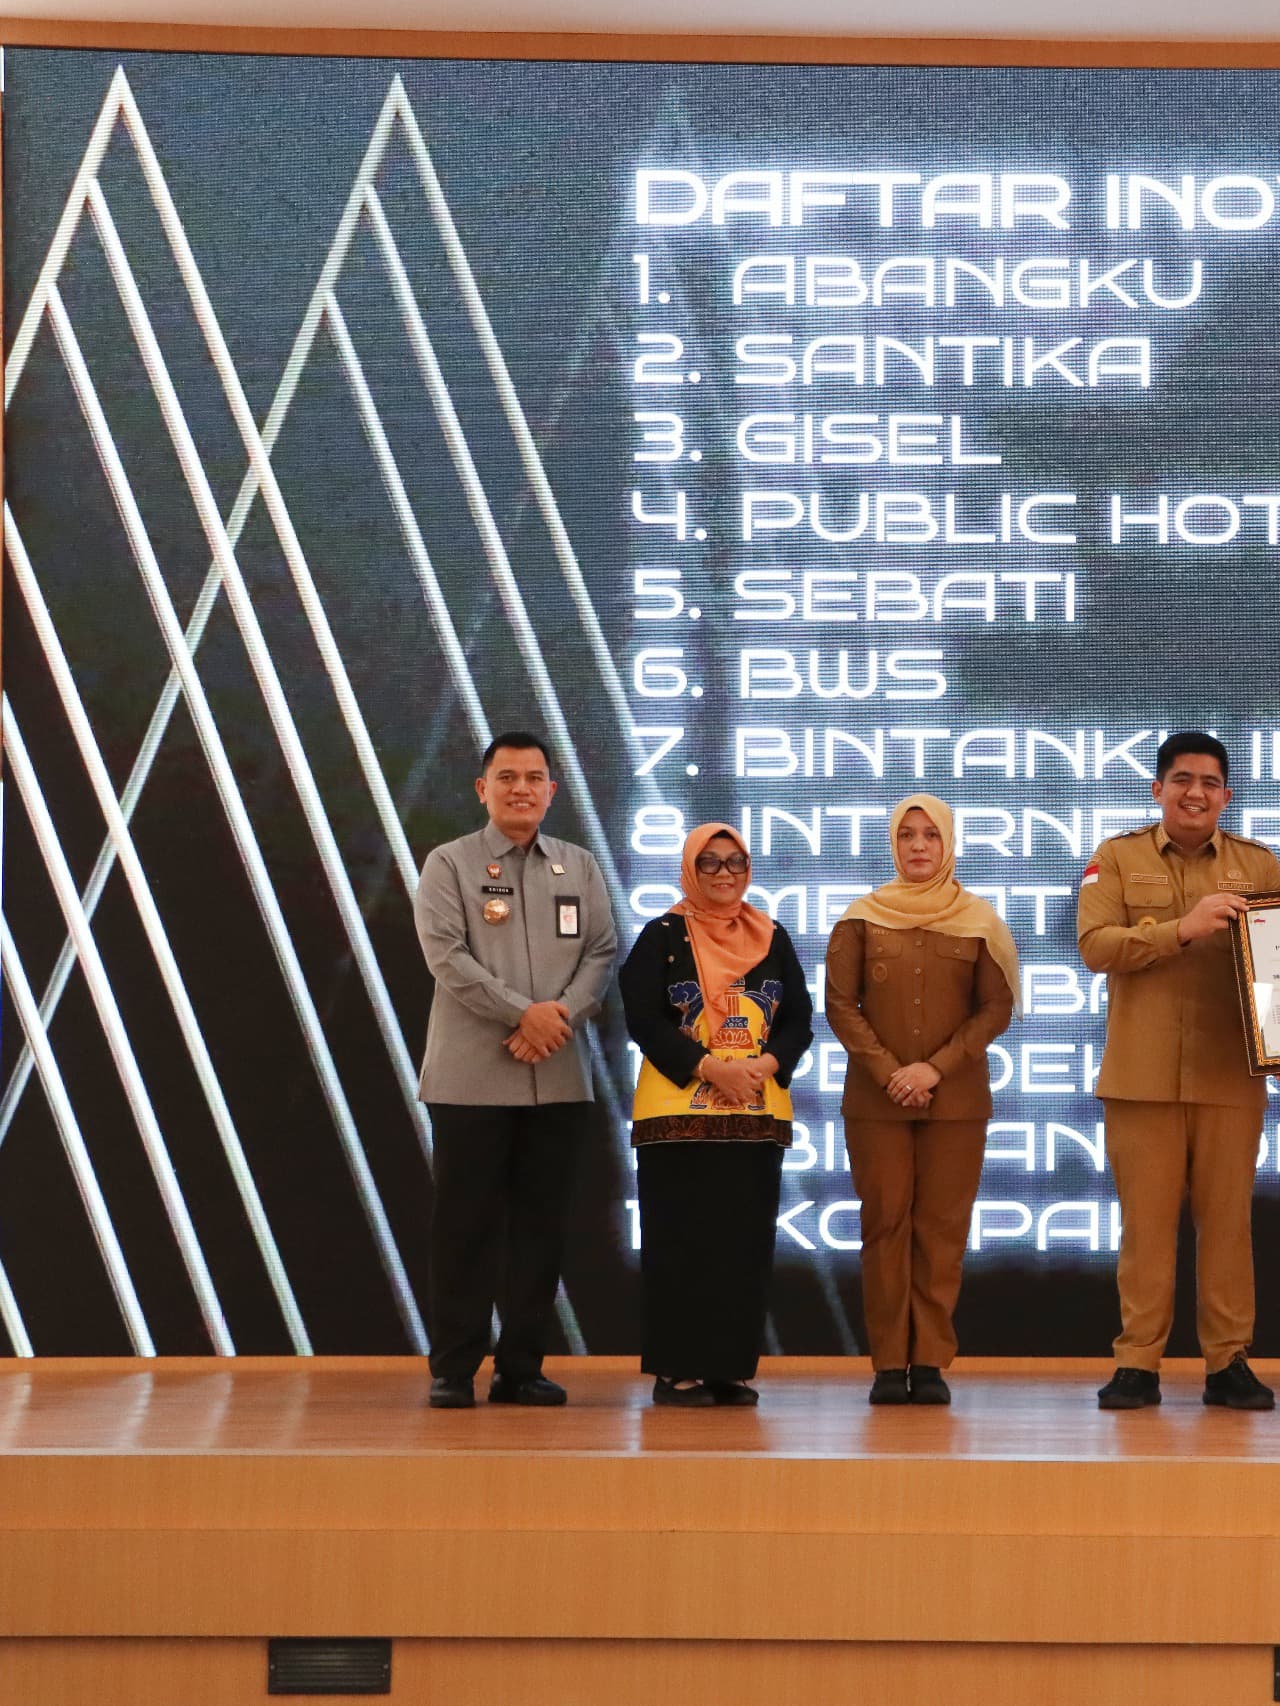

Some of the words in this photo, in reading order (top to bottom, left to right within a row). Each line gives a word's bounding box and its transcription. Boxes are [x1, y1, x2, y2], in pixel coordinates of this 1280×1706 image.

[634, 169, 1072, 231] DAFTAR
[633, 254, 671, 305] 1.
[732, 254, 1204, 310] ABANGKU
[633, 333, 701, 384] 2.
[734, 334, 1152, 387] SANTIKA
[633, 411, 702, 462] 3.
[736, 412, 1002, 466] GISEL
[632, 491, 707, 541] 4.
[740, 490, 1077, 544] PUBLIC
[633, 569, 702, 619] 5.
[733, 569, 1076, 623] SEBATI
[632, 647, 704, 698] 6.
[740, 648, 947, 701] BWS
[630, 726, 699, 777] 7.
[735, 727, 1217, 779] BINTANK
[742, 806, 1163, 858] INTRNE
